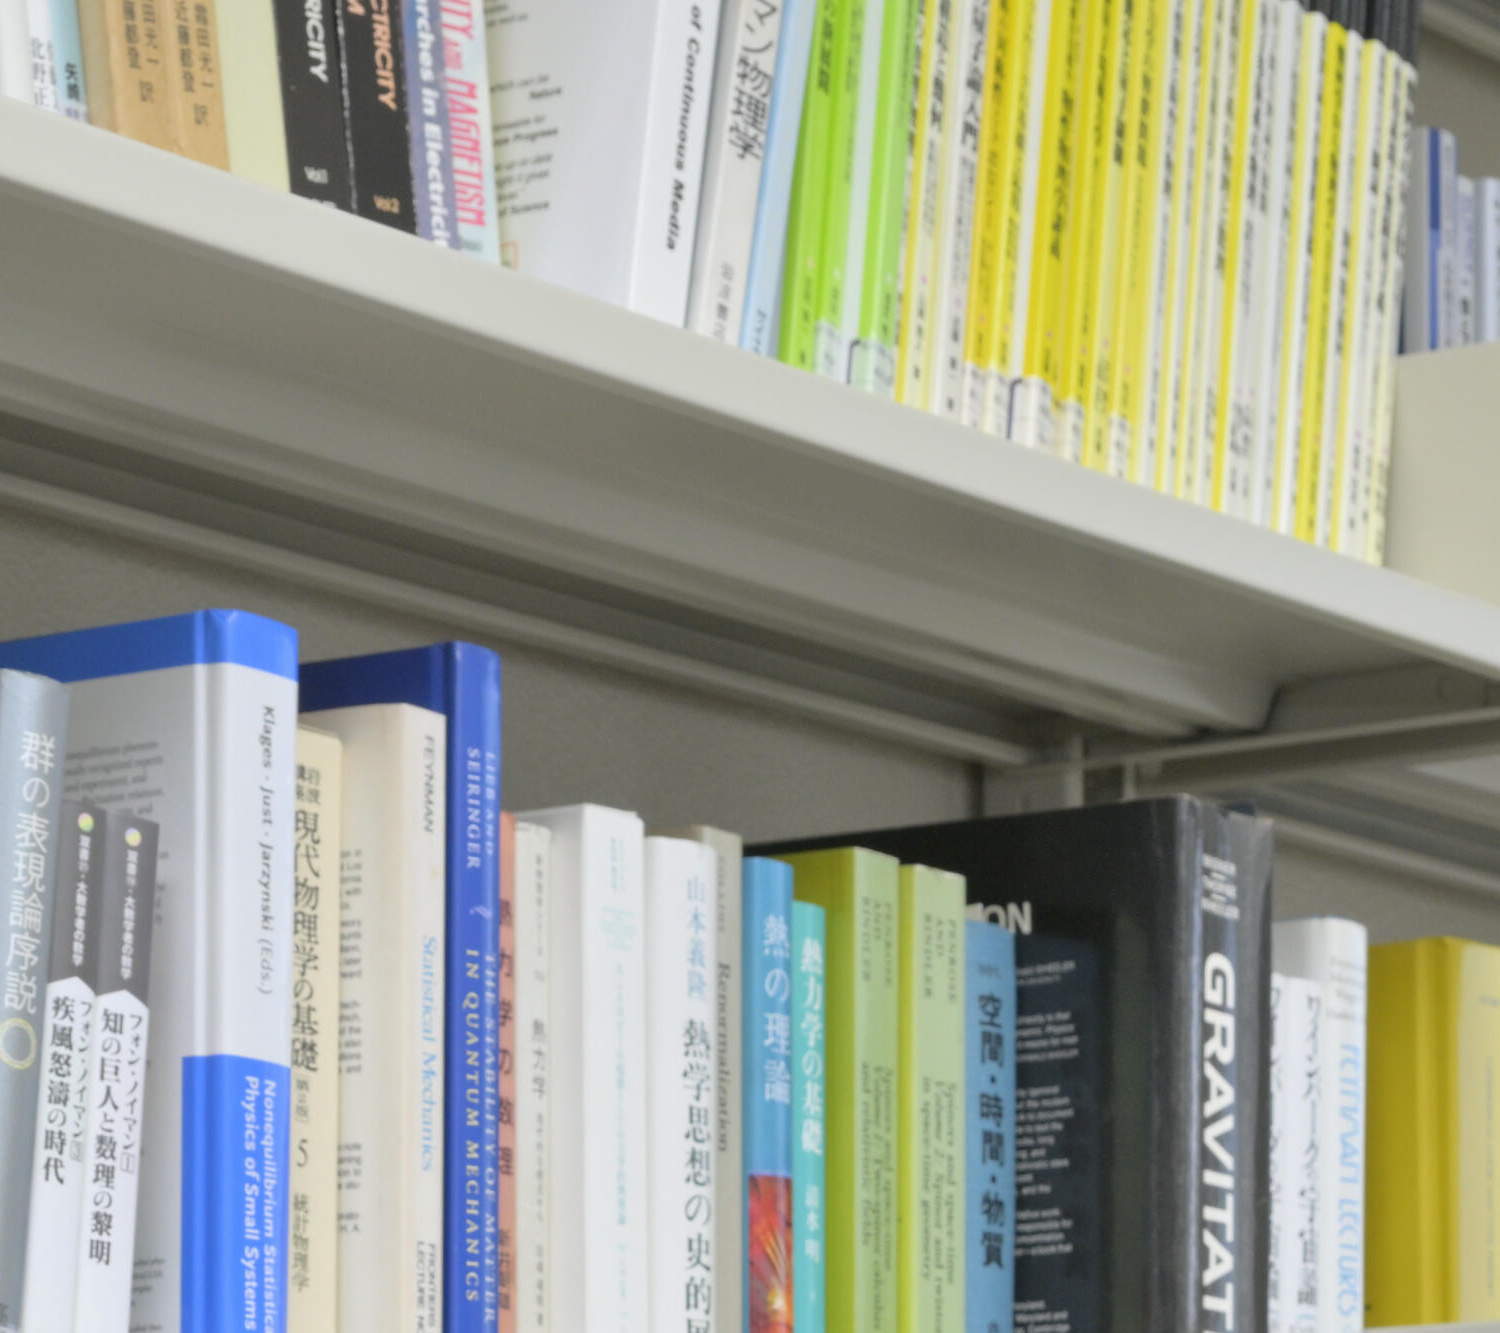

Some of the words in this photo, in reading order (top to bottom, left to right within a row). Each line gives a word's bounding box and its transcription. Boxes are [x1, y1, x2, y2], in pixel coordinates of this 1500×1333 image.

[444, 77, 487, 227] MAGNETISM
[674, 37, 699, 171] Continuous
[666, 178, 686, 251] Media
[422, 735, 436, 834] FEYNMAN
[466, 747, 481, 870] SEIRINGER
[4, 730, 57, 1016] 群の表現論序説
[466, 948, 480, 978] IN
[42, 995, 76, 1186] 疾風怒濤の時代
[242, 1076, 259, 1152] Physics
[462, 990, 480, 1128] QUANTUM
[801, 937, 824, 1155] 熱力学の基礎
[88, 1008, 125, 1268] 知の巨人と数理の黎明
[244, 1157, 260, 1180] of
[264, 1080, 276, 1239] Nonequilibrium
[978, 991, 1006, 1271] 空間・時間・物質
[244, 1182, 260, 1240] Small
[464, 1140, 480, 1303] MECHANICS
[242, 1246, 260, 1330] Systems
